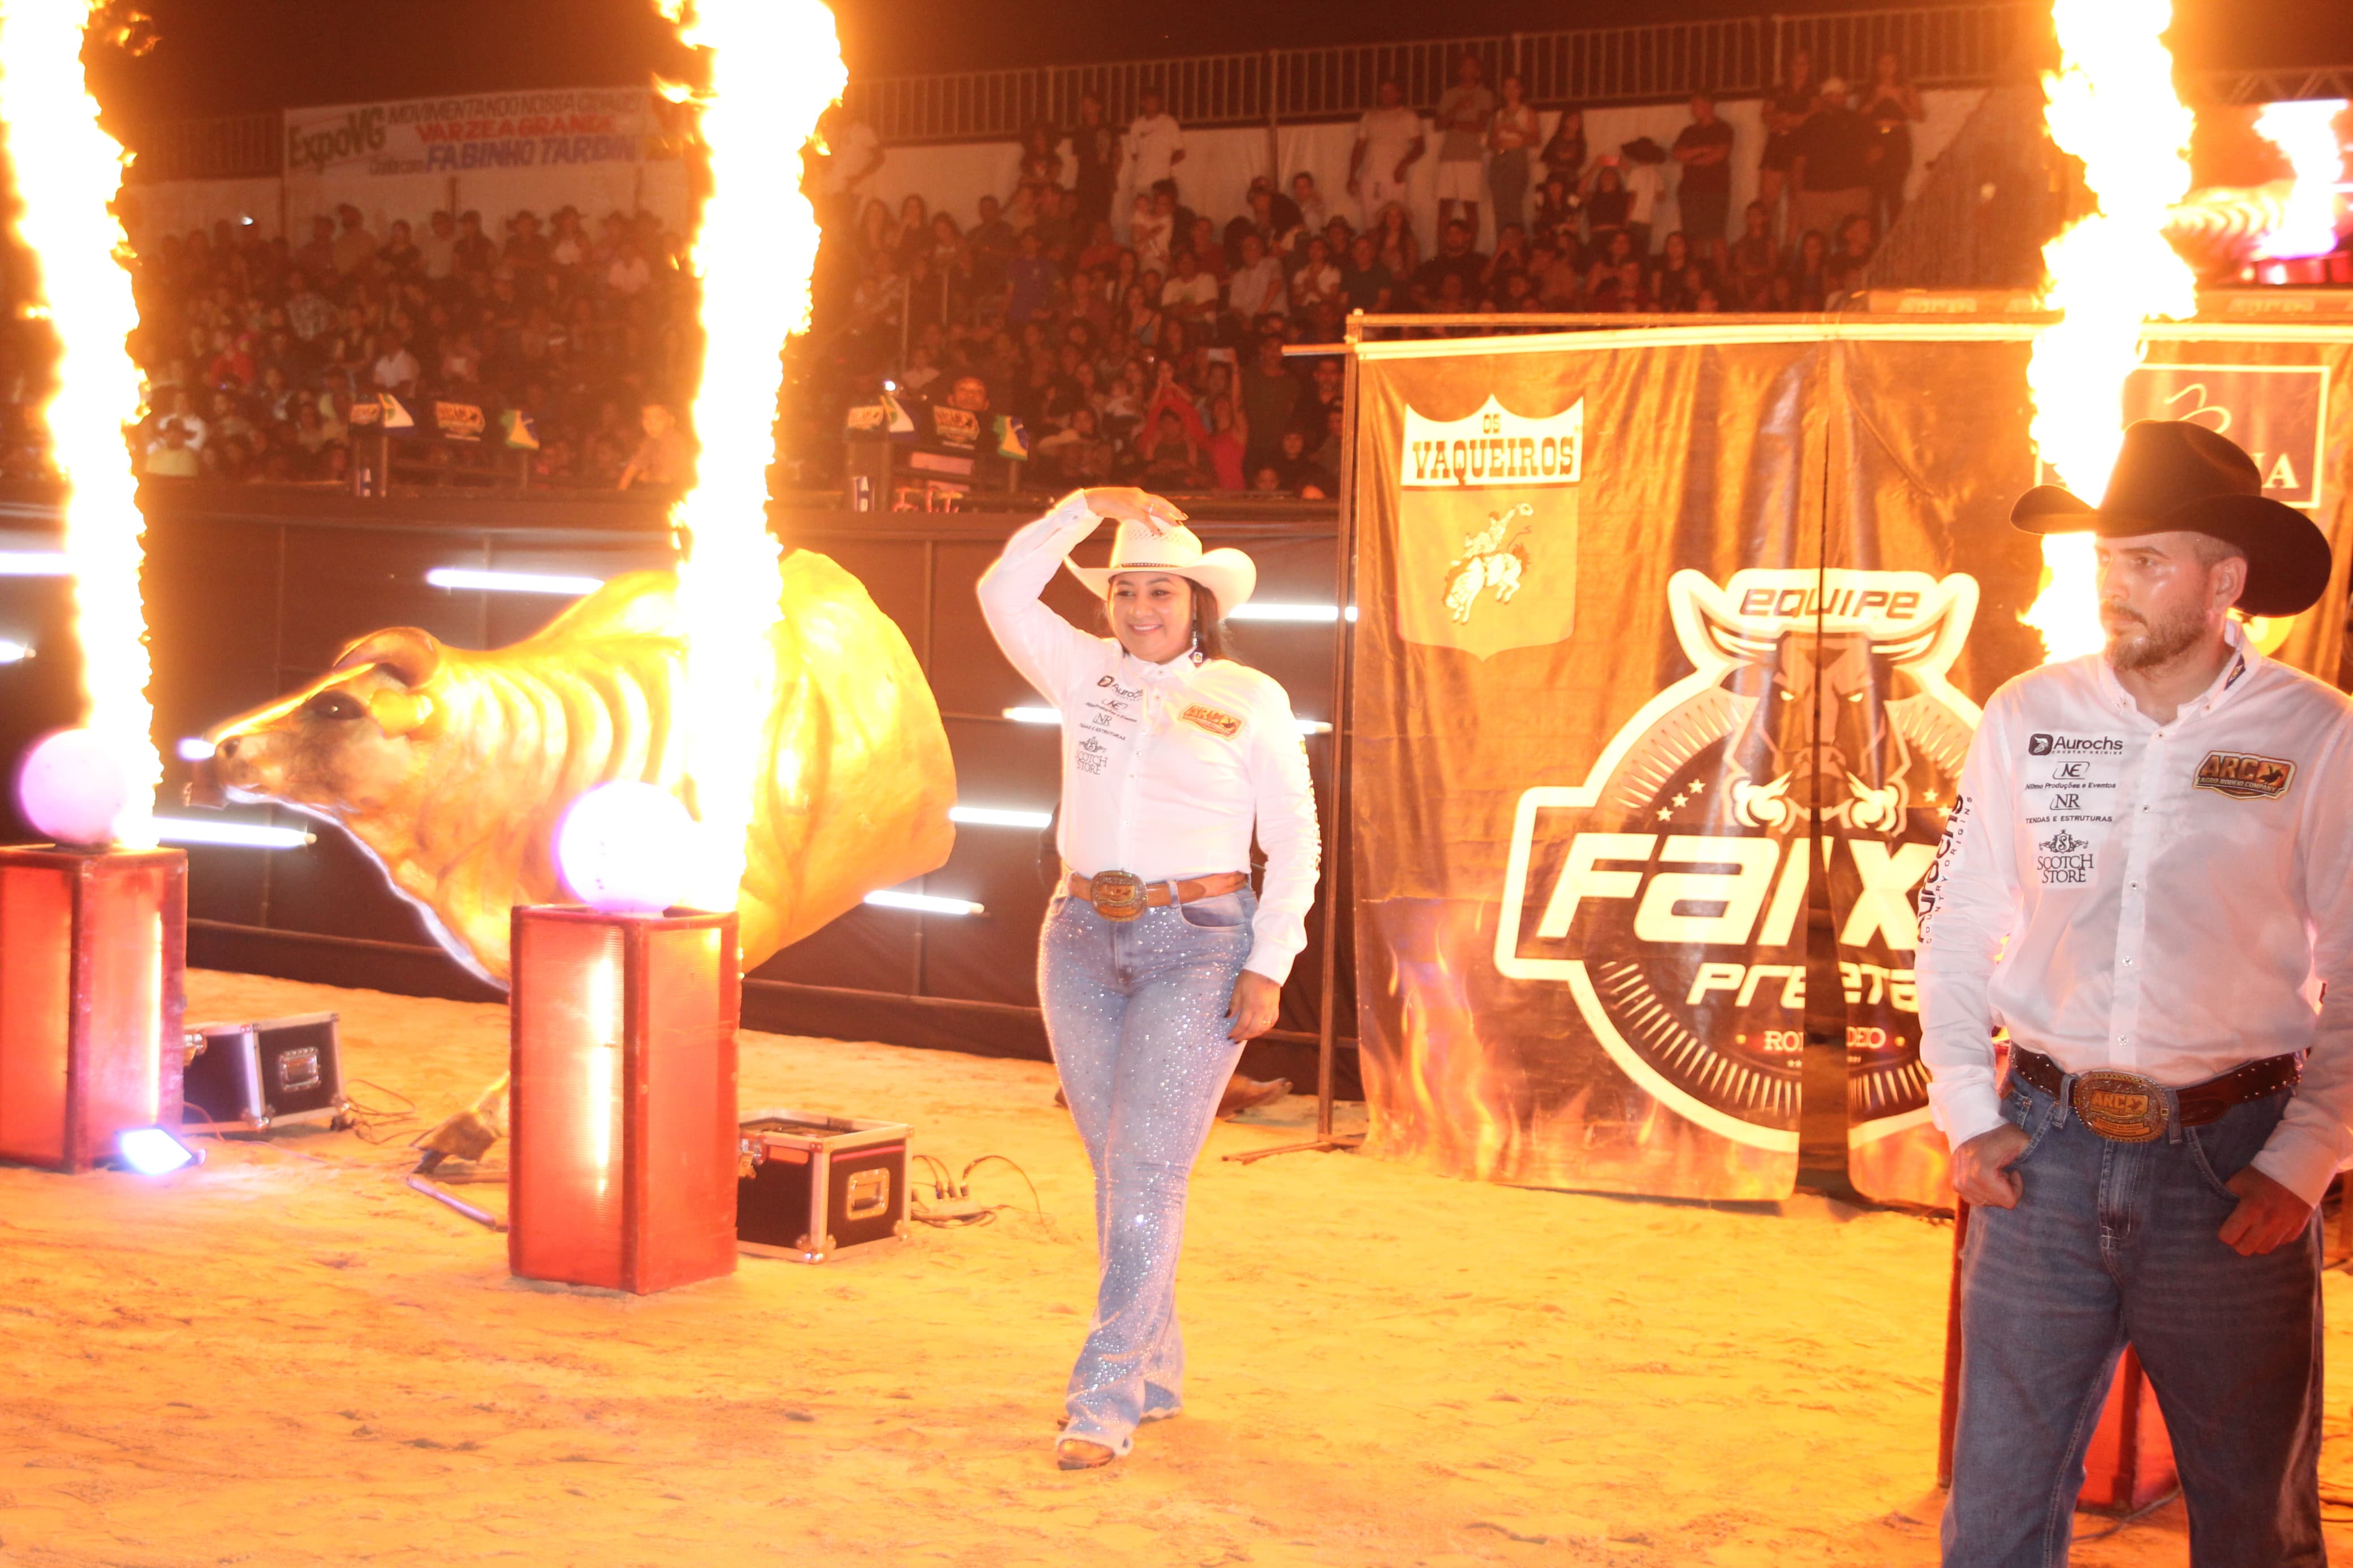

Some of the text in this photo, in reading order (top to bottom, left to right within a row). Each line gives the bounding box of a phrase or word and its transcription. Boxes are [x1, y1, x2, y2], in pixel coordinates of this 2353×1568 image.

[426, 139, 536, 172] FABINHO
[1483, 413, 1501, 434] OS
[1412, 437, 1575, 486] VAQUEIROS
[2053, 736, 2123, 750] Aurochs
[2199, 755, 2260, 780] ARC
[2244, 781, 2277, 792] COMPANY
[2054, 793, 2081, 808] NR
[1925, 796, 1972, 944] COUNTRY ORIGINS
[2037, 854, 2094, 870] SCOTCH
[2042, 869, 2086, 883] STORE
